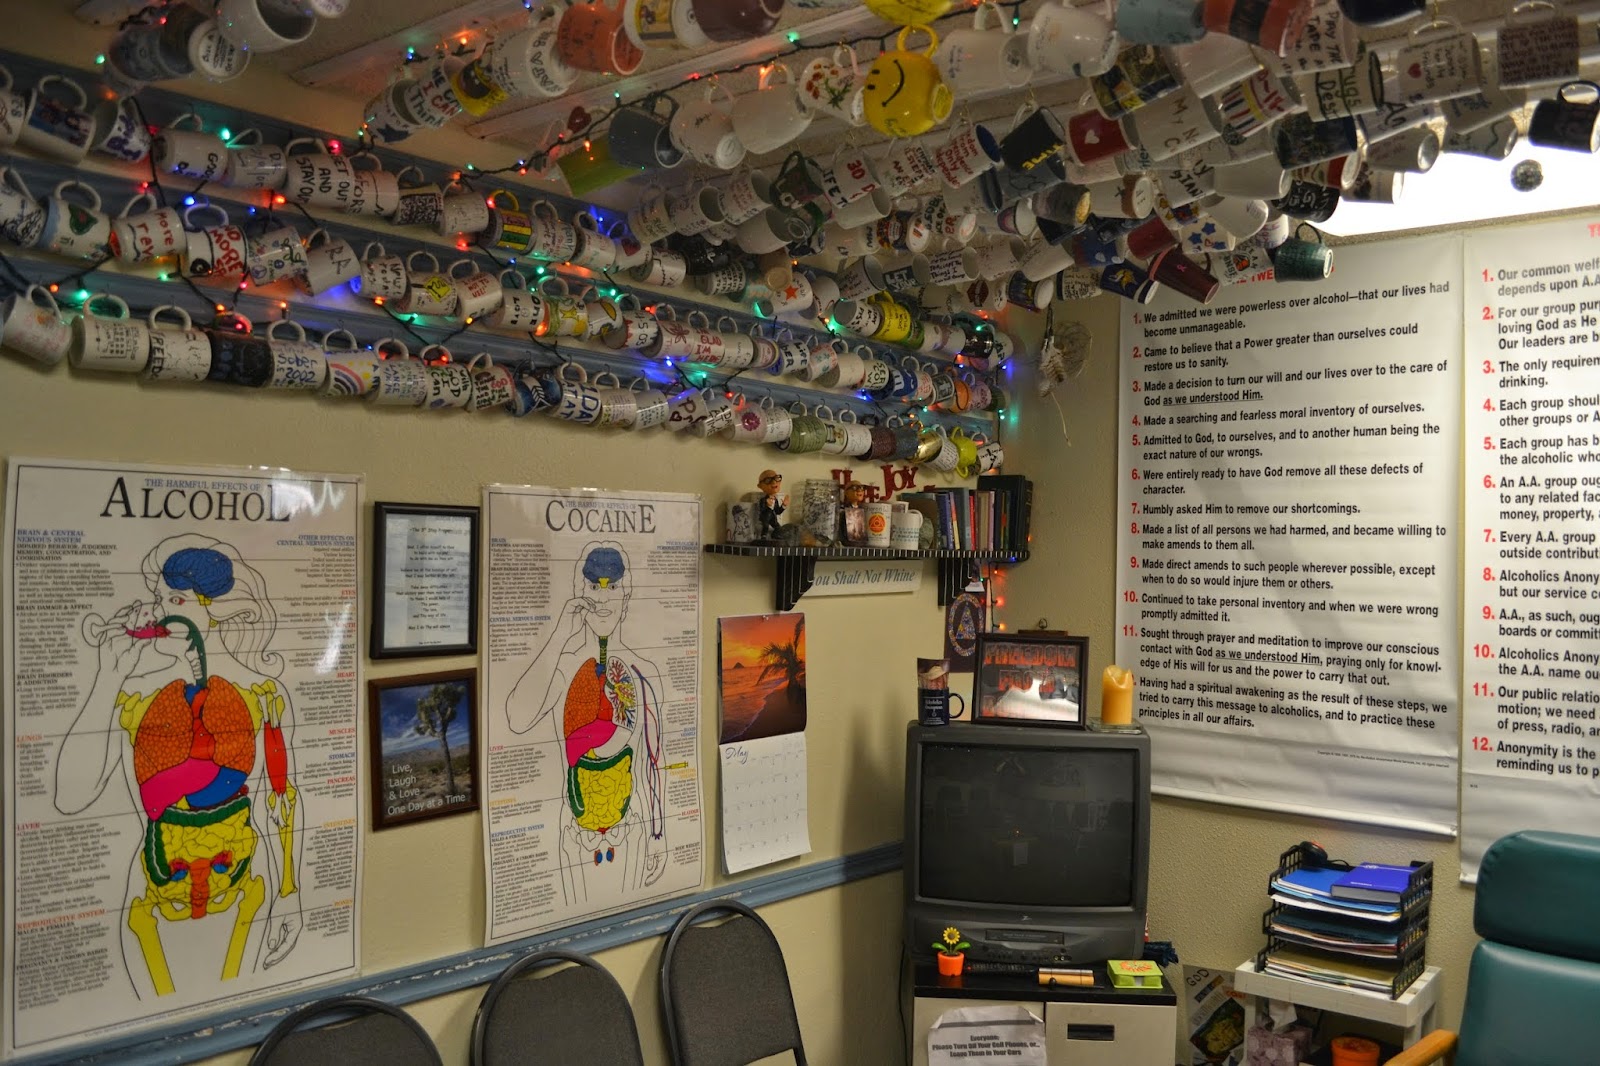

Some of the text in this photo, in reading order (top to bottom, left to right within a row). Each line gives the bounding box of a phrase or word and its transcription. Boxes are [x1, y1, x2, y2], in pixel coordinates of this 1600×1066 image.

[295, 157, 316, 186] STAY
[318, 167, 332, 193] AND
[208, 229, 244, 273] MORE
[885, 269, 908, 282] LET
[1482, 268, 1494, 282] 1.
[1497, 269, 1518, 281] Our
[1522, 264, 1570, 278] common
[1133, 312, 1142, 324] 1.
[1144, 313, 1157, 323] We
[1159, 308, 1197, 322] admitted
[1199, 308, 1212, 317] we
[1215, 306, 1237, 315] were
[1239, 300, 1286, 316] powerless
[1289, 298, 1310, 308] over
[1382, 289, 1399, 298] our
[1402, 285, 1426, 296] lives
[1429, 281, 1449, 293] had
[1144, 318, 1246, 338] become unmanageable.
[1144, 356, 1229, 372] restore us to sanity.
[1483, 360, 1495, 374] 3.
[1499, 360, 1520, 372] The
[1523, 358, 1548, 372] only
[285, 367, 318, 384] 2002
[1499, 374, 1548, 388] drinking.
[1144, 388, 1264, 406] God as we understood Him.
[1132, 402, 1425, 426] 4. Made a searching and fearless moral inventory of ourselves.
[145, 478, 261, 492] THE HARMFUL EFFECTS OF
[100, 477, 290, 522] ALCOHOL
[545, 500, 656, 534] COCAINE
[1131, 502, 1360, 516] 7. Humbly asked Him to remove our shortcomings.
[1483, 529, 1596, 545] 7. Every A.A. group
[832, 570, 861, 586] Shalt
[862, 569, 882, 584] Not
[884, 568, 916, 582] Whine
[1482, 605, 1495, 620] 9.
[1499, 608, 1525, 623] A.A.,
[1528, 612, 1542, 621] as
[1545, 610, 1576, 625] such,
[1473, 682, 1494, 697] 11.
[1498, 686, 1519, 698] Our
[1522, 688, 1557, 701] public
[1139, 706, 1254, 727] principles in all our affairs.
[328, 752, 356, 760] STOMACH
[1472, 736, 1596, 760] 12. Anonymity is the
[392, 764, 413, 775] Live,
[327, 776, 356, 785] PANCREAS
[389, 775, 417, 788] Laugh
[389, 788, 421, 801] & Love
[387, 794, 466, 816] One Day at a Time
[16, 822, 41, 831] LIVER
[16, 908, 106, 930] REPRODUCTIVE SYSTEM
